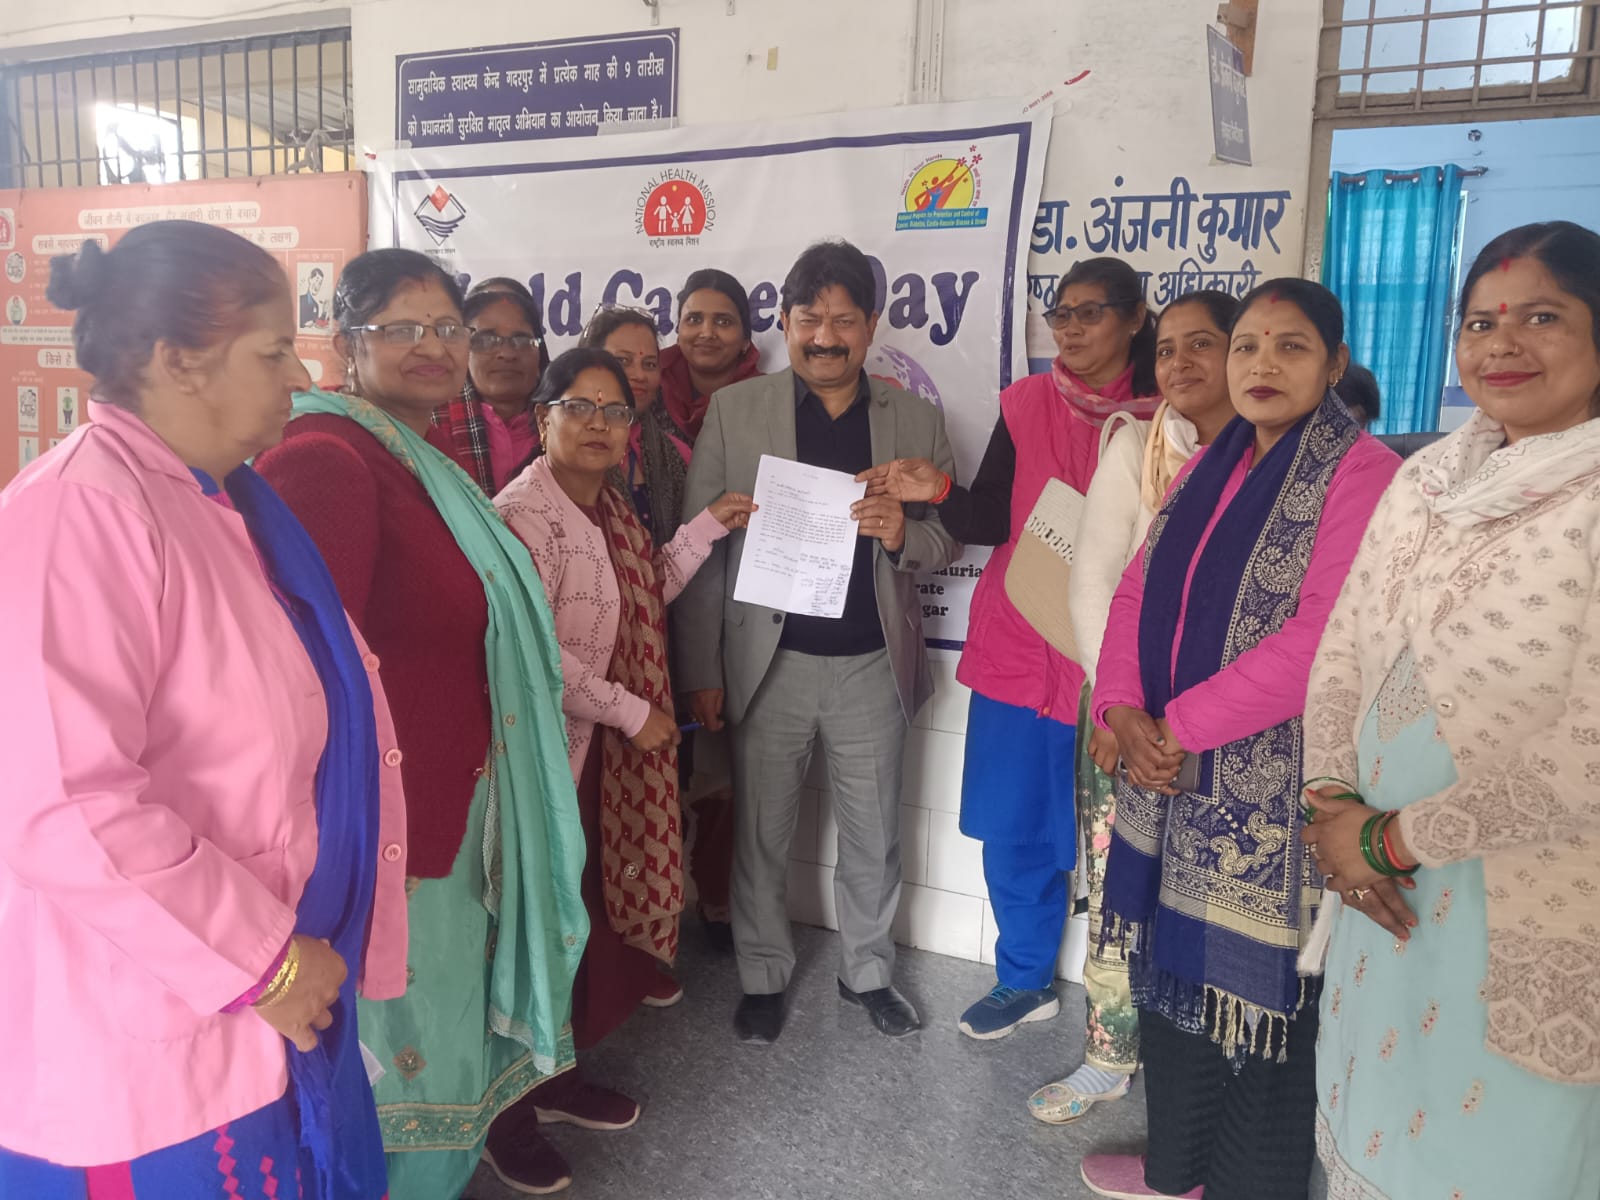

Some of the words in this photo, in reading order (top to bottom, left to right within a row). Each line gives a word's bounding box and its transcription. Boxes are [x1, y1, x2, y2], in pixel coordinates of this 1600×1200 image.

[408, 70, 446, 101] सामुदायिक
[483, 66, 500, 88] केन्द्र
[506, 69, 533, 93] गदरपुर
[539, 61, 547, 84] में
[554, 59, 578, 84] प्रत्येक
[584, 63, 600, 81] माह
[606, 55, 618, 79] की
[637, 52, 664, 77] तारीख
[408, 114, 417, 136] को
[421, 112, 454, 136] प्रधानमंत्री
[458, 111, 484, 141] सुरक्षित
[488, 115, 511, 138] मातृत्व
[515, 107, 547, 130] अभियान
[550, 112, 561, 128] का
[566, 103, 599, 127] आयोजन
[603, 101, 623, 125] किया
[627, 106, 647, 122] जाता
[635, 177, 660, 234] NATIONAL
[660, 168, 697, 184] HEALTH
[697, 179, 716, 232] MISSION
[1084, 175, 1199, 253] अंजनी
[1197, 190, 1291, 264] कुमार
[922, 605, 949, 618] gar
